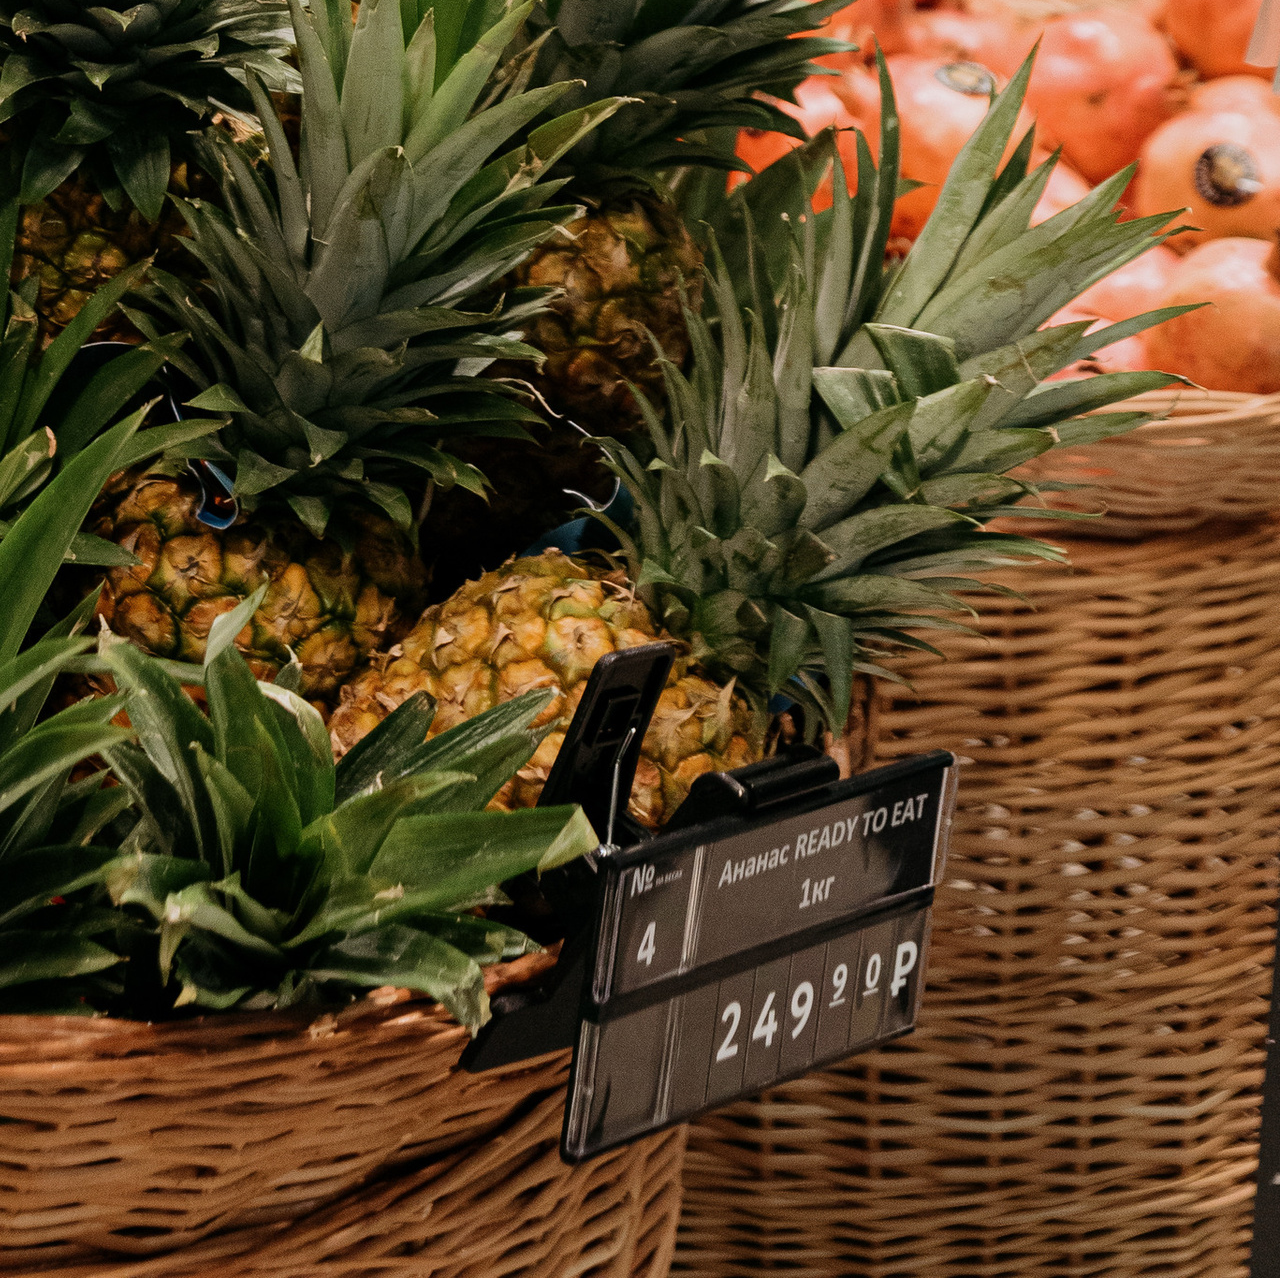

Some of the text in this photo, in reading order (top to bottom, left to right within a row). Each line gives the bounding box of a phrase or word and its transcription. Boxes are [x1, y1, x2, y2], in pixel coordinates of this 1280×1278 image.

[718, 793, 929, 889] Ананас READY TO EAT
[799, 876, 835, 909] 1кг
[637, 921, 656, 966] 4
[716, 981, 814, 1063] 249
